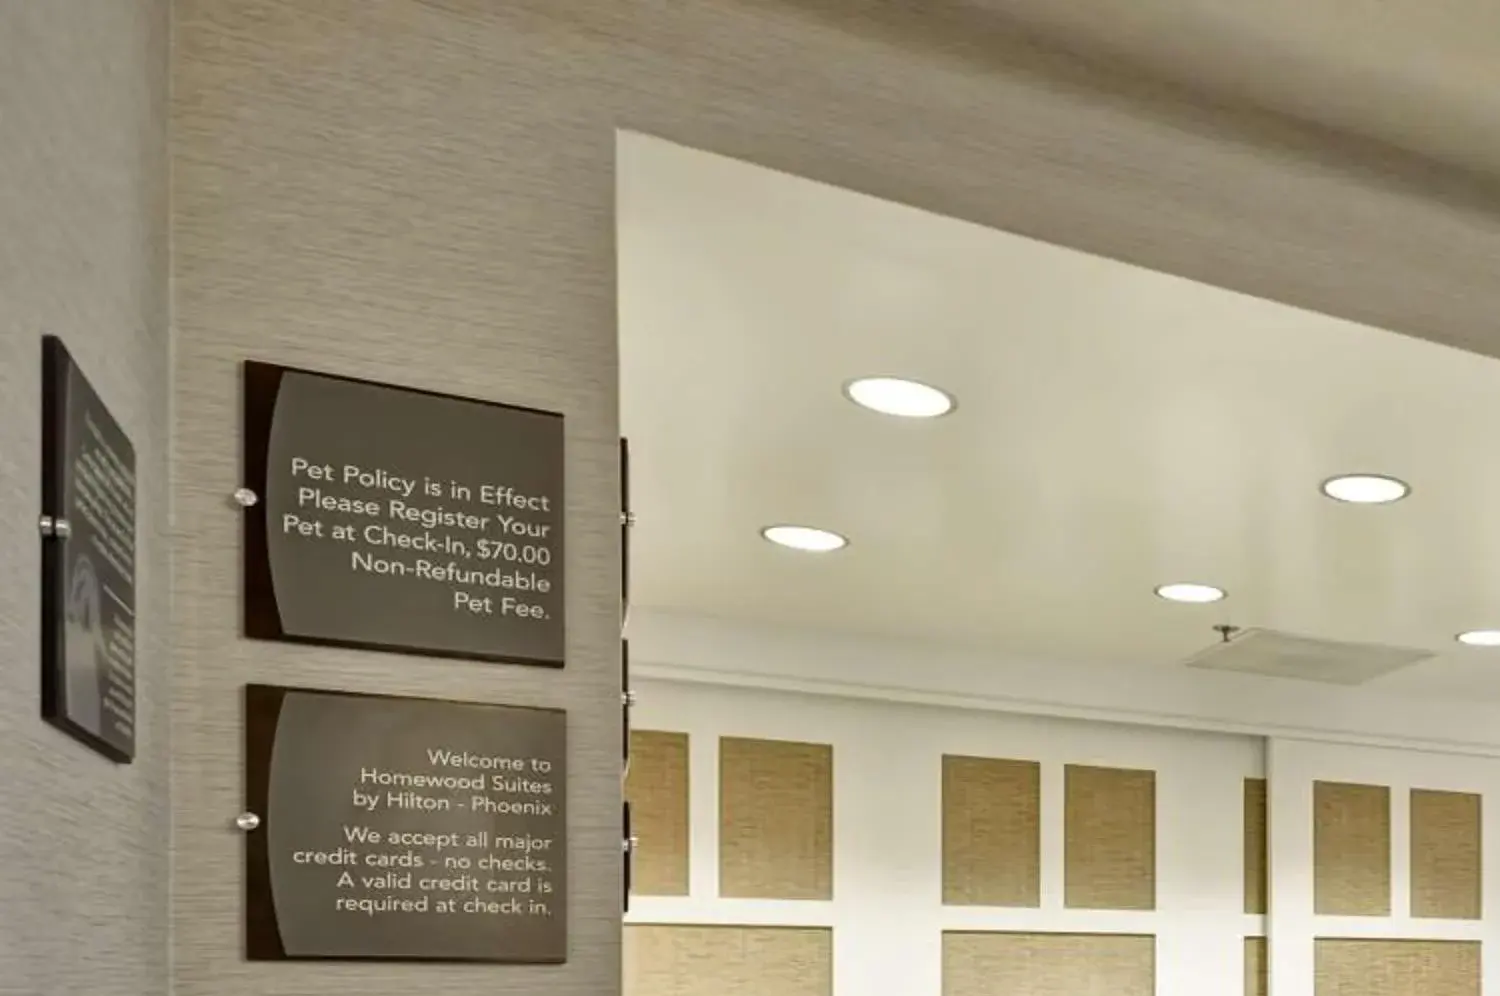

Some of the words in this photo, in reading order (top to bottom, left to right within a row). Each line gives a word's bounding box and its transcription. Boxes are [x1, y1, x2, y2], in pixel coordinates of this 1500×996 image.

[291, 457, 334, 482] Pet
[343, 465, 416, 497] Policy
[424, 476, 442, 496] is
[451, 480, 471, 500] in
[480, 485, 550, 512] Effect
[298, 487, 380, 516] Please
[389, 500, 490, 531] Register
[497, 514, 550, 538] Your
[283, 515, 323, 538] Pet
[332, 522, 356, 541] at
[364, 525, 472, 558] Check-In,
[476, 538, 550, 566] $70.00
[351, 551, 551, 594] Non-Refundable
[454, 592, 492, 613] Pet
[502, 599, 549, 620] Fee.
[427, 748, 523, 772] Welcome
[531, 754, 551, 773] to
[361, 768, 485, 791] Homewood
[492, 775, 552, 794] Suites
[353, 790, 378, 812] by
[387, 791, 449, 811] Hilton
[471, 797, 552, 816] Phoenix
[343, 826, 381, 845] We
[388, 830, 459, 853] accept
[465, 829, 488, 848] all
[495, 833, 552, 855] major
[293, 847, 356, 867] credit
[365, 848, 422, 869] cards
[445, 854, 471, 870] no
[478, 853, 551, 873] checks.
[336, 871, 354, 889] A
[362, 873, 411, 890] valid
[419, 875, 479, 893] credit
[487, 876, 531, 894] card
[537, 877, 552, 895] is
[336, 896, 429, 918] required
[435, 897, 456, 914] at
[463, 898, 523, 915] check
[530, 899, 551, 916] in.
